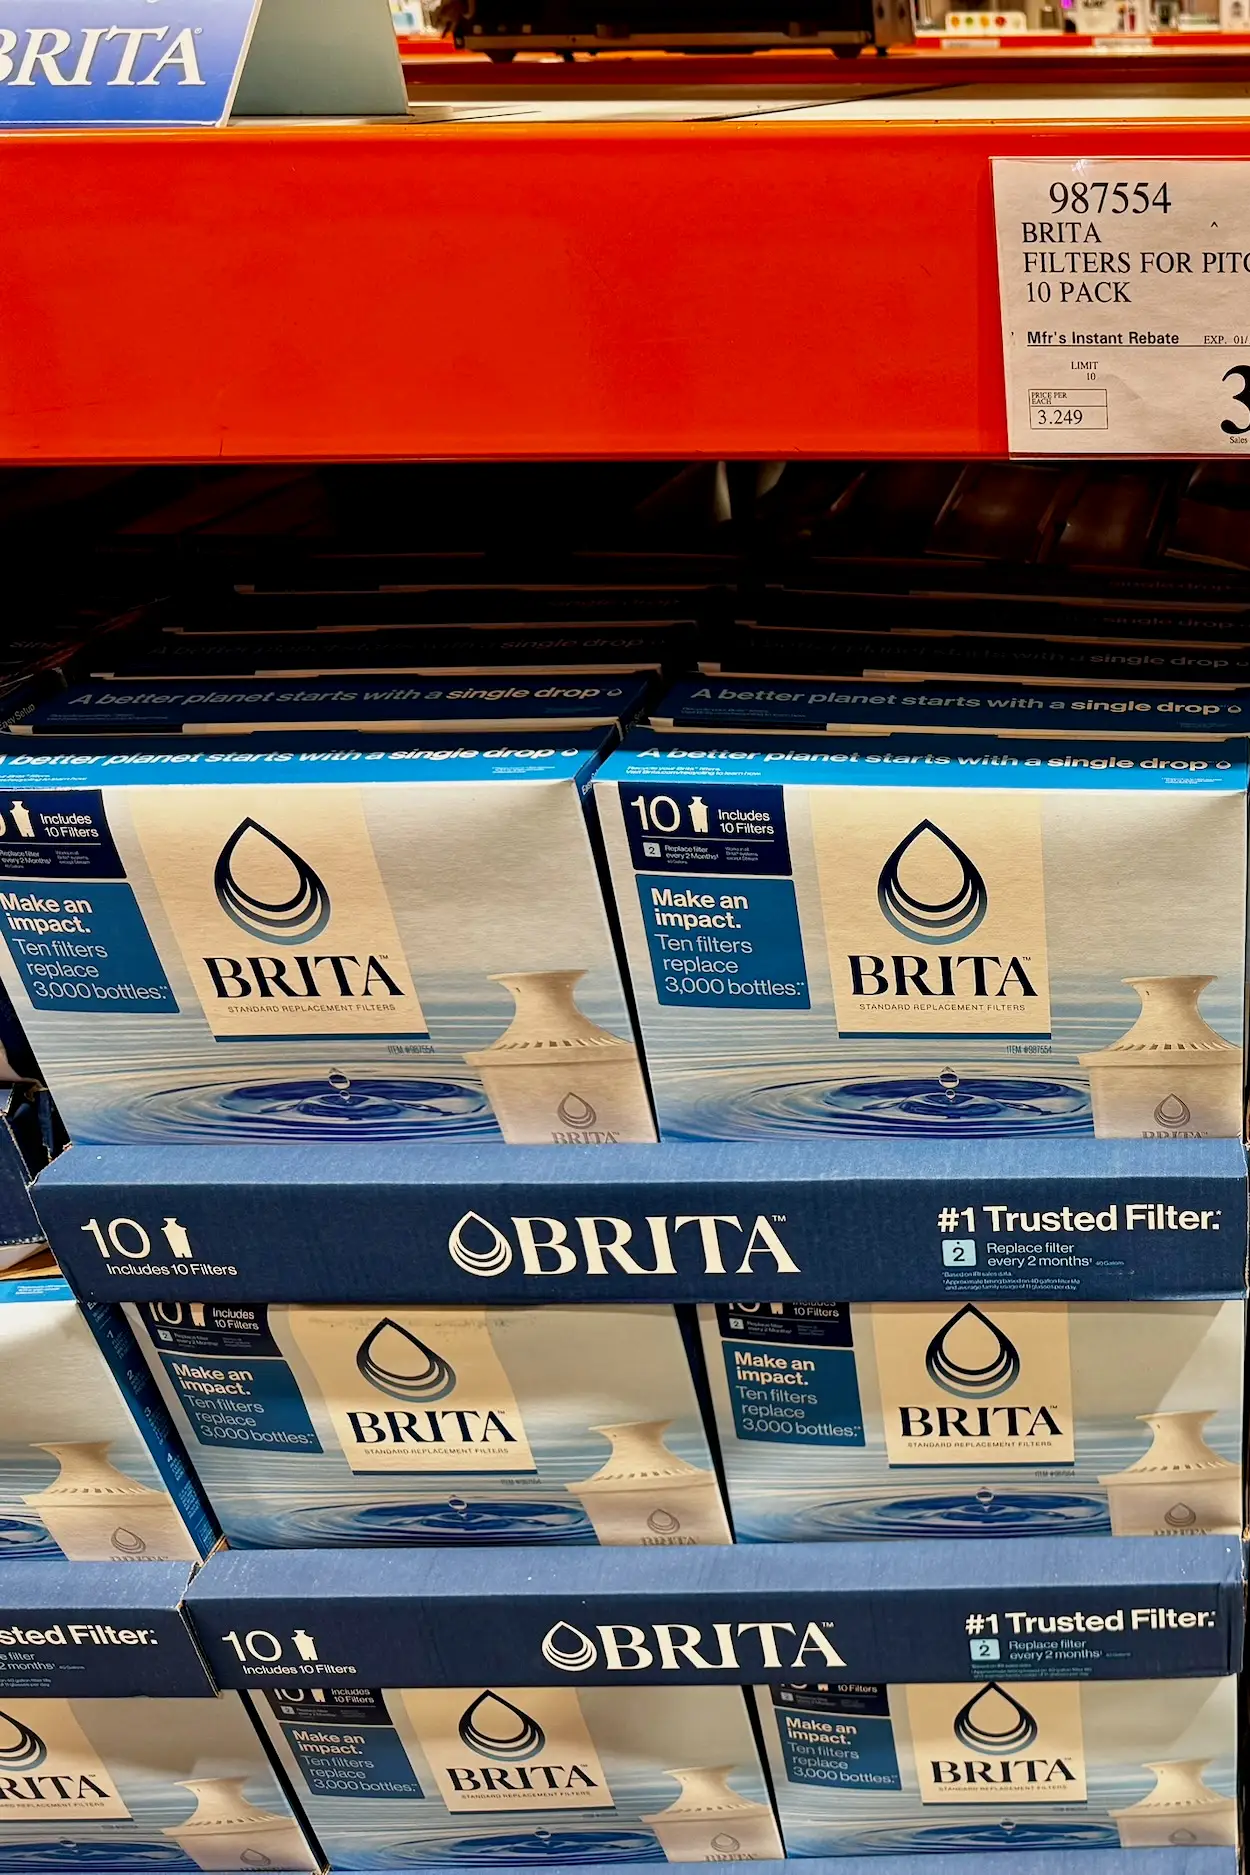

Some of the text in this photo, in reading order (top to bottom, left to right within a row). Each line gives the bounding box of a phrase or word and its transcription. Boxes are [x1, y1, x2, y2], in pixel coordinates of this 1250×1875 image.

[1050, 181, 1172, 214] 987554
[1021, 222, 1102, 243] BRITA
[1023, 252, 1131, 273] FILTERS
[1140, 252, 1193, 273] FOR
[1026, 281, 1132, 303] 10 PACK
[1027, 331, 1180, 344] Mfr's Instant Rebate
[1204, 335, 1227, 345] EXP.
[1071, 361, 1099, 370] LIMIT
[1086, 372, 1096, 381] 10
[1031, 391, 1068, 399] PRICE PER
[1037, 409, 1083, 425] 3.249
[1229, 436, 1248, 445] Sales
[636, 748, 1209, 772] A better planet starts with a single drop
[630, 795, 682, 833] 10
[717, 808, 771, 823] Includes
[719, 822, 775, 836] 10 Filters
[648, 847, 656, 856] 2
[665, 852, 685, 860] every
[650, 887, 749, 910] Make an
[654, 908, 742, 931] impact.
[653, 933, 753, 954] Ten filters
[662, 955, 739, 975] replace
[664, 976, 725, 996] 3,000
[859, 1003, 1026, 1012] STANDARD REPLACEMENT FILTERS
[937, 1206, 976, 1233] #1
[982, 1204, 1118, 1232] Trusted
[80, 1217, 151, 1259] 10
[952, 1246, 966, 1262] 2
[986, 1242, 1075, 1255] Replace filter
[106, 1263, 238, 1276] Includes 10 Filters
[987, 1256, 1026, 1269] every
[1027, 1256, 1037, 1266] 2
